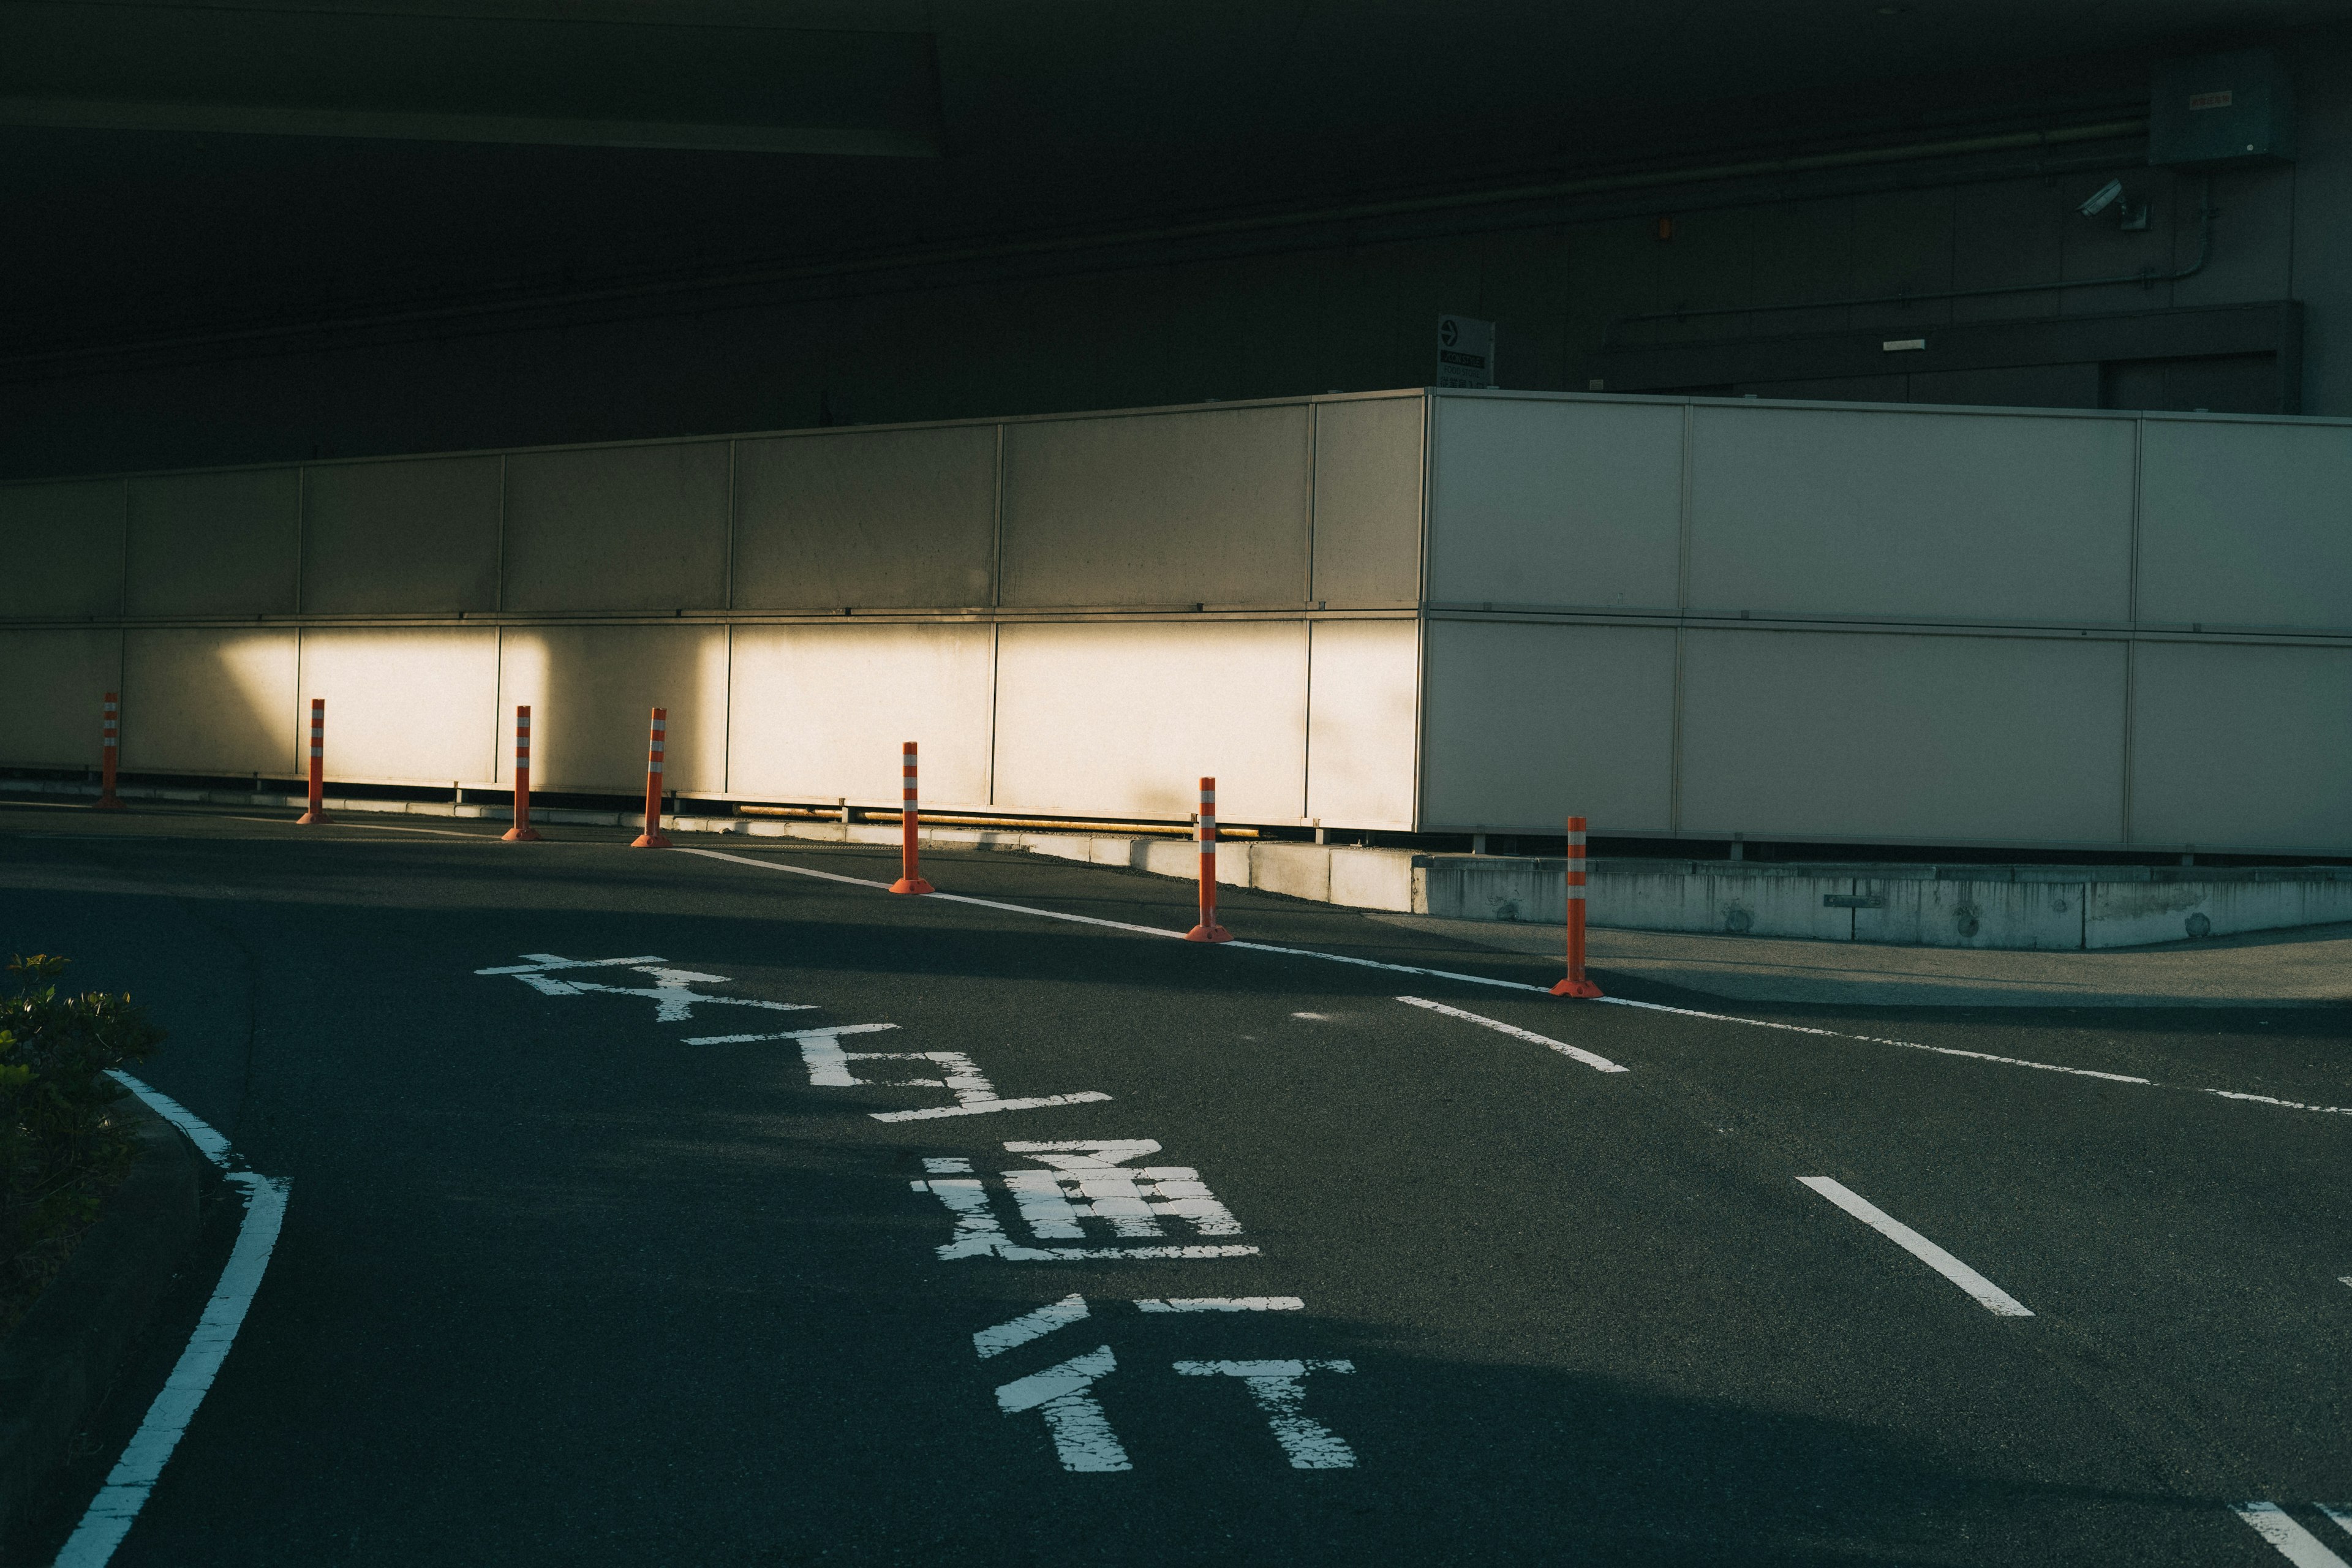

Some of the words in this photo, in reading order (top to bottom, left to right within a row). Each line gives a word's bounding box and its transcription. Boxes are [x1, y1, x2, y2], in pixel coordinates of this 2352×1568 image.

[1462, 355, 1480, 366] STYLE
[1444, 365, 1461, 375] FOOD
[1462, 368, 1480, 379] STORE
[473, 953, 1358, 1472] 交互通行
